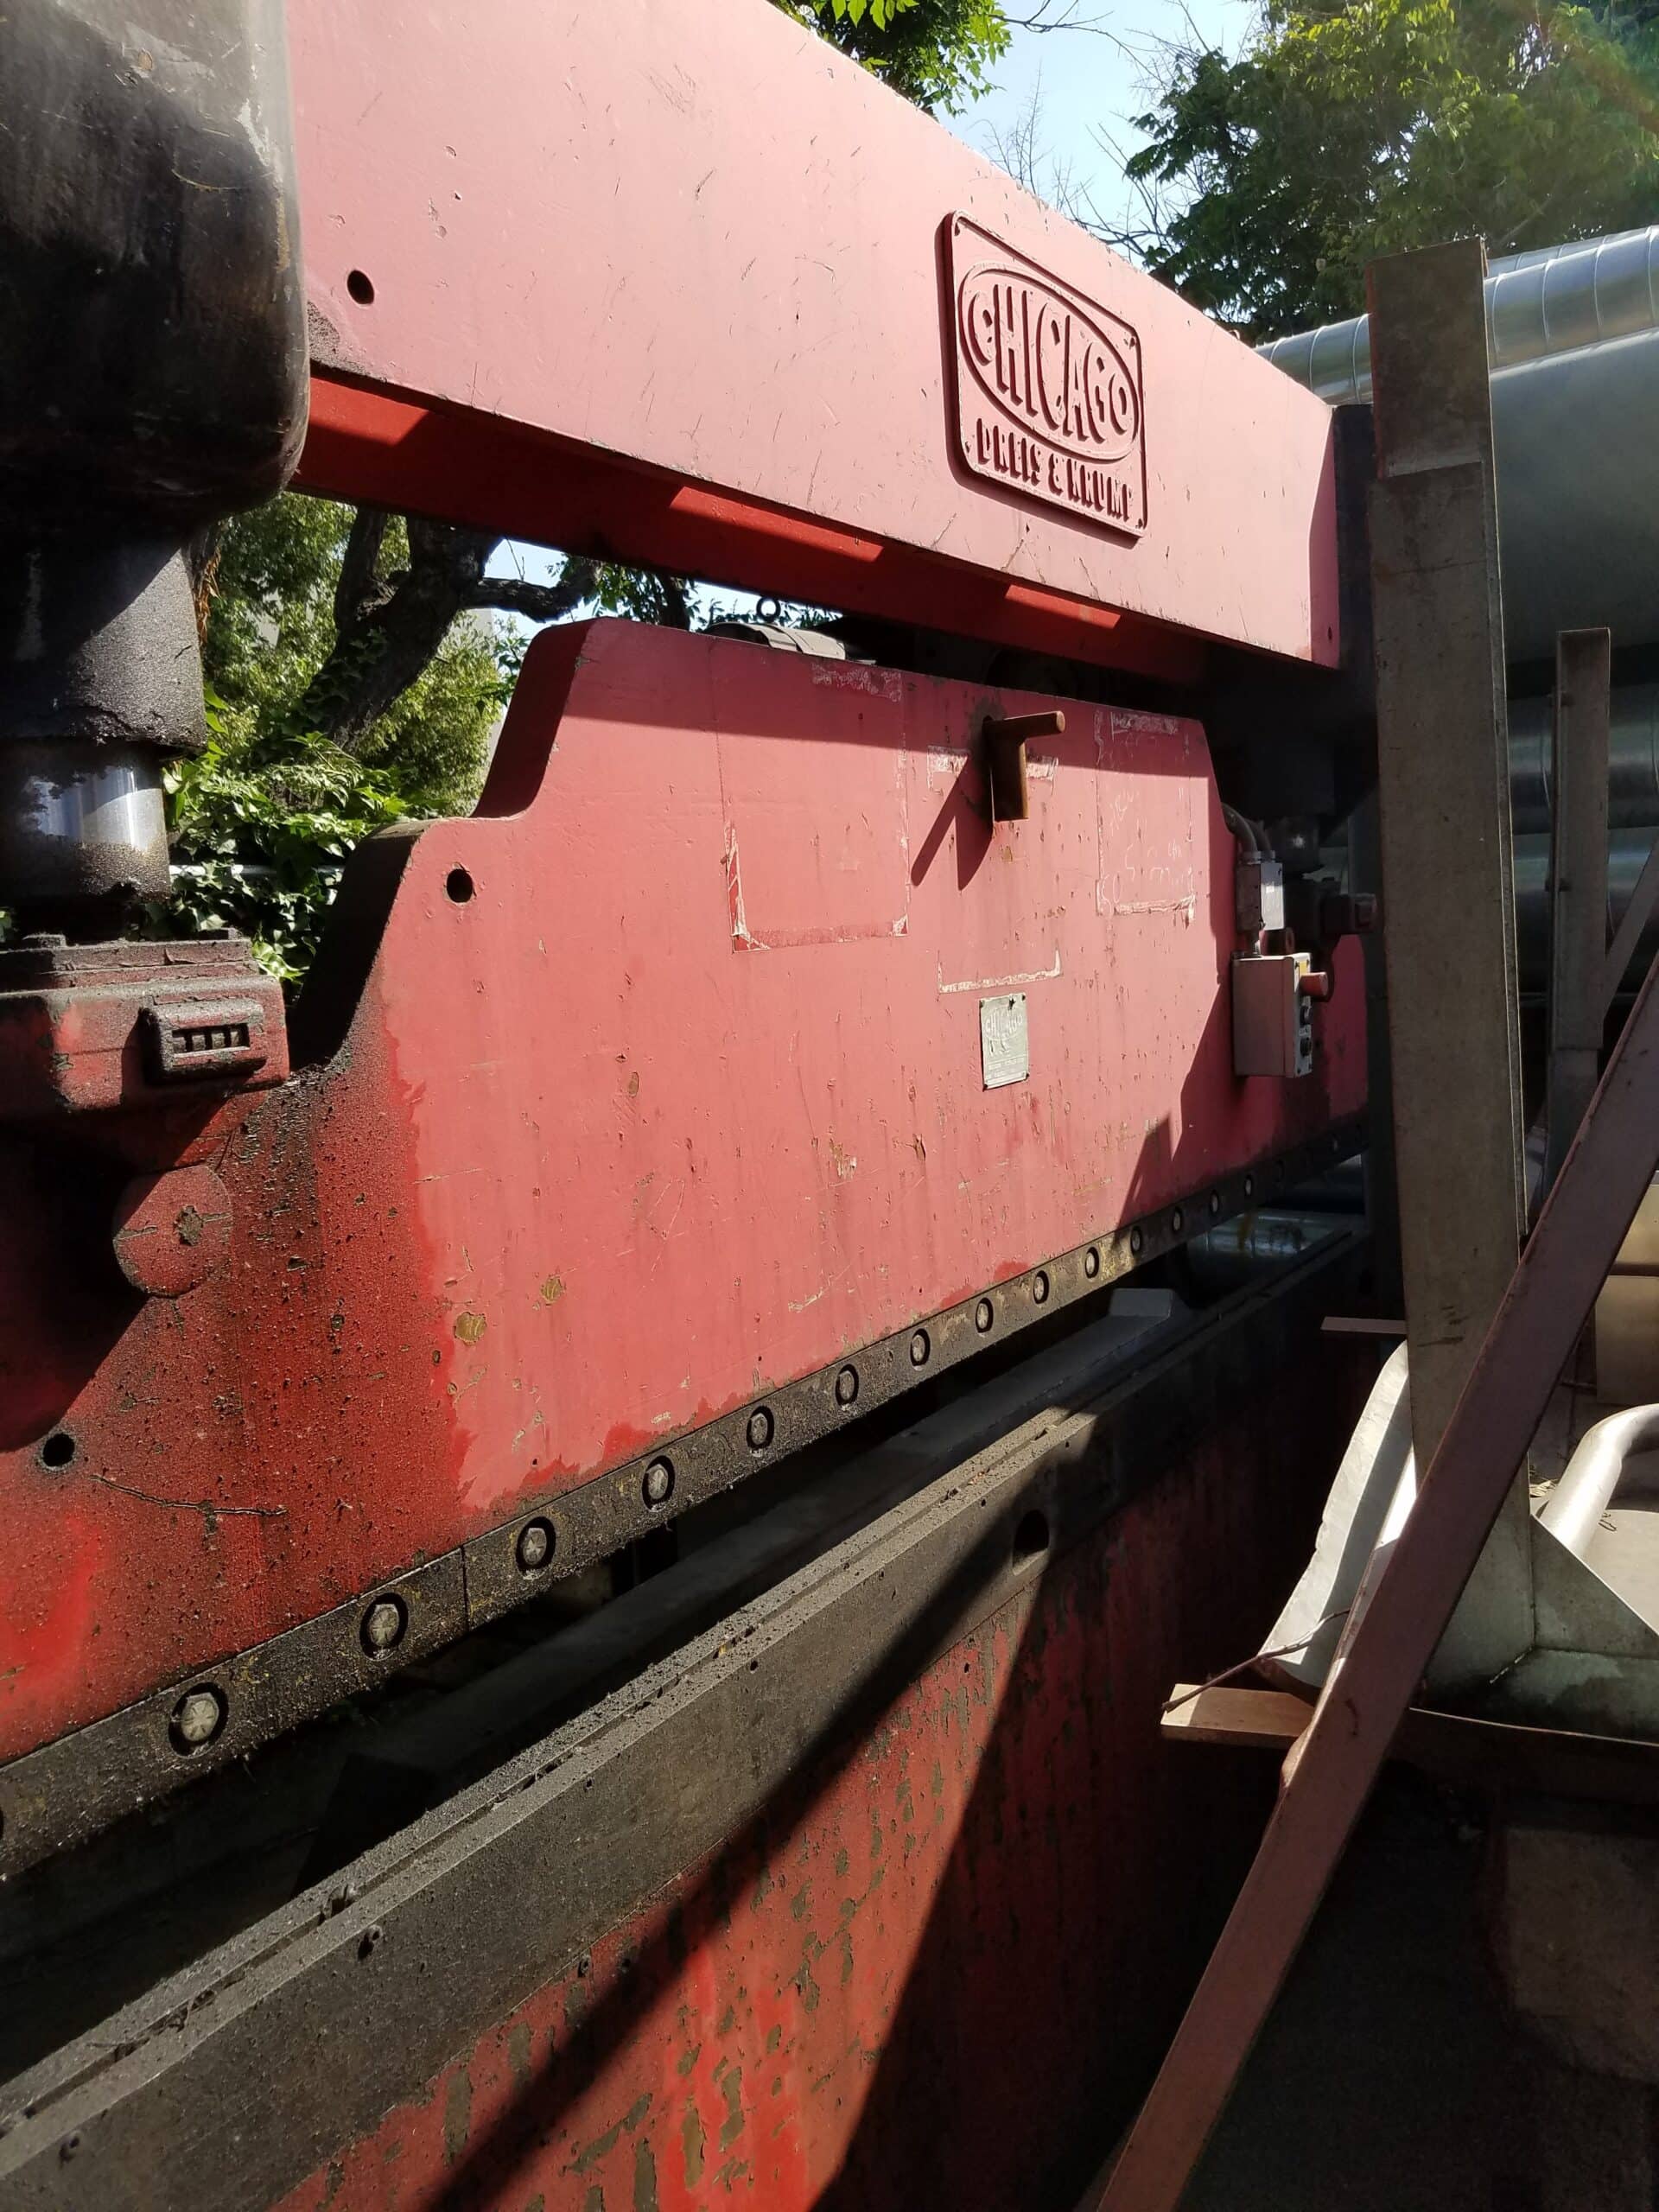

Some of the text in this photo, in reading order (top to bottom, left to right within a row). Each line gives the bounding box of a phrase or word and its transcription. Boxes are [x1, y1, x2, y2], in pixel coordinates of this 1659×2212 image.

[968, 283, 1133, 444] CHICAGO
[976, 418, 1041, 486] DREIS
[1067, 458, 1133, 522] KRUMP
